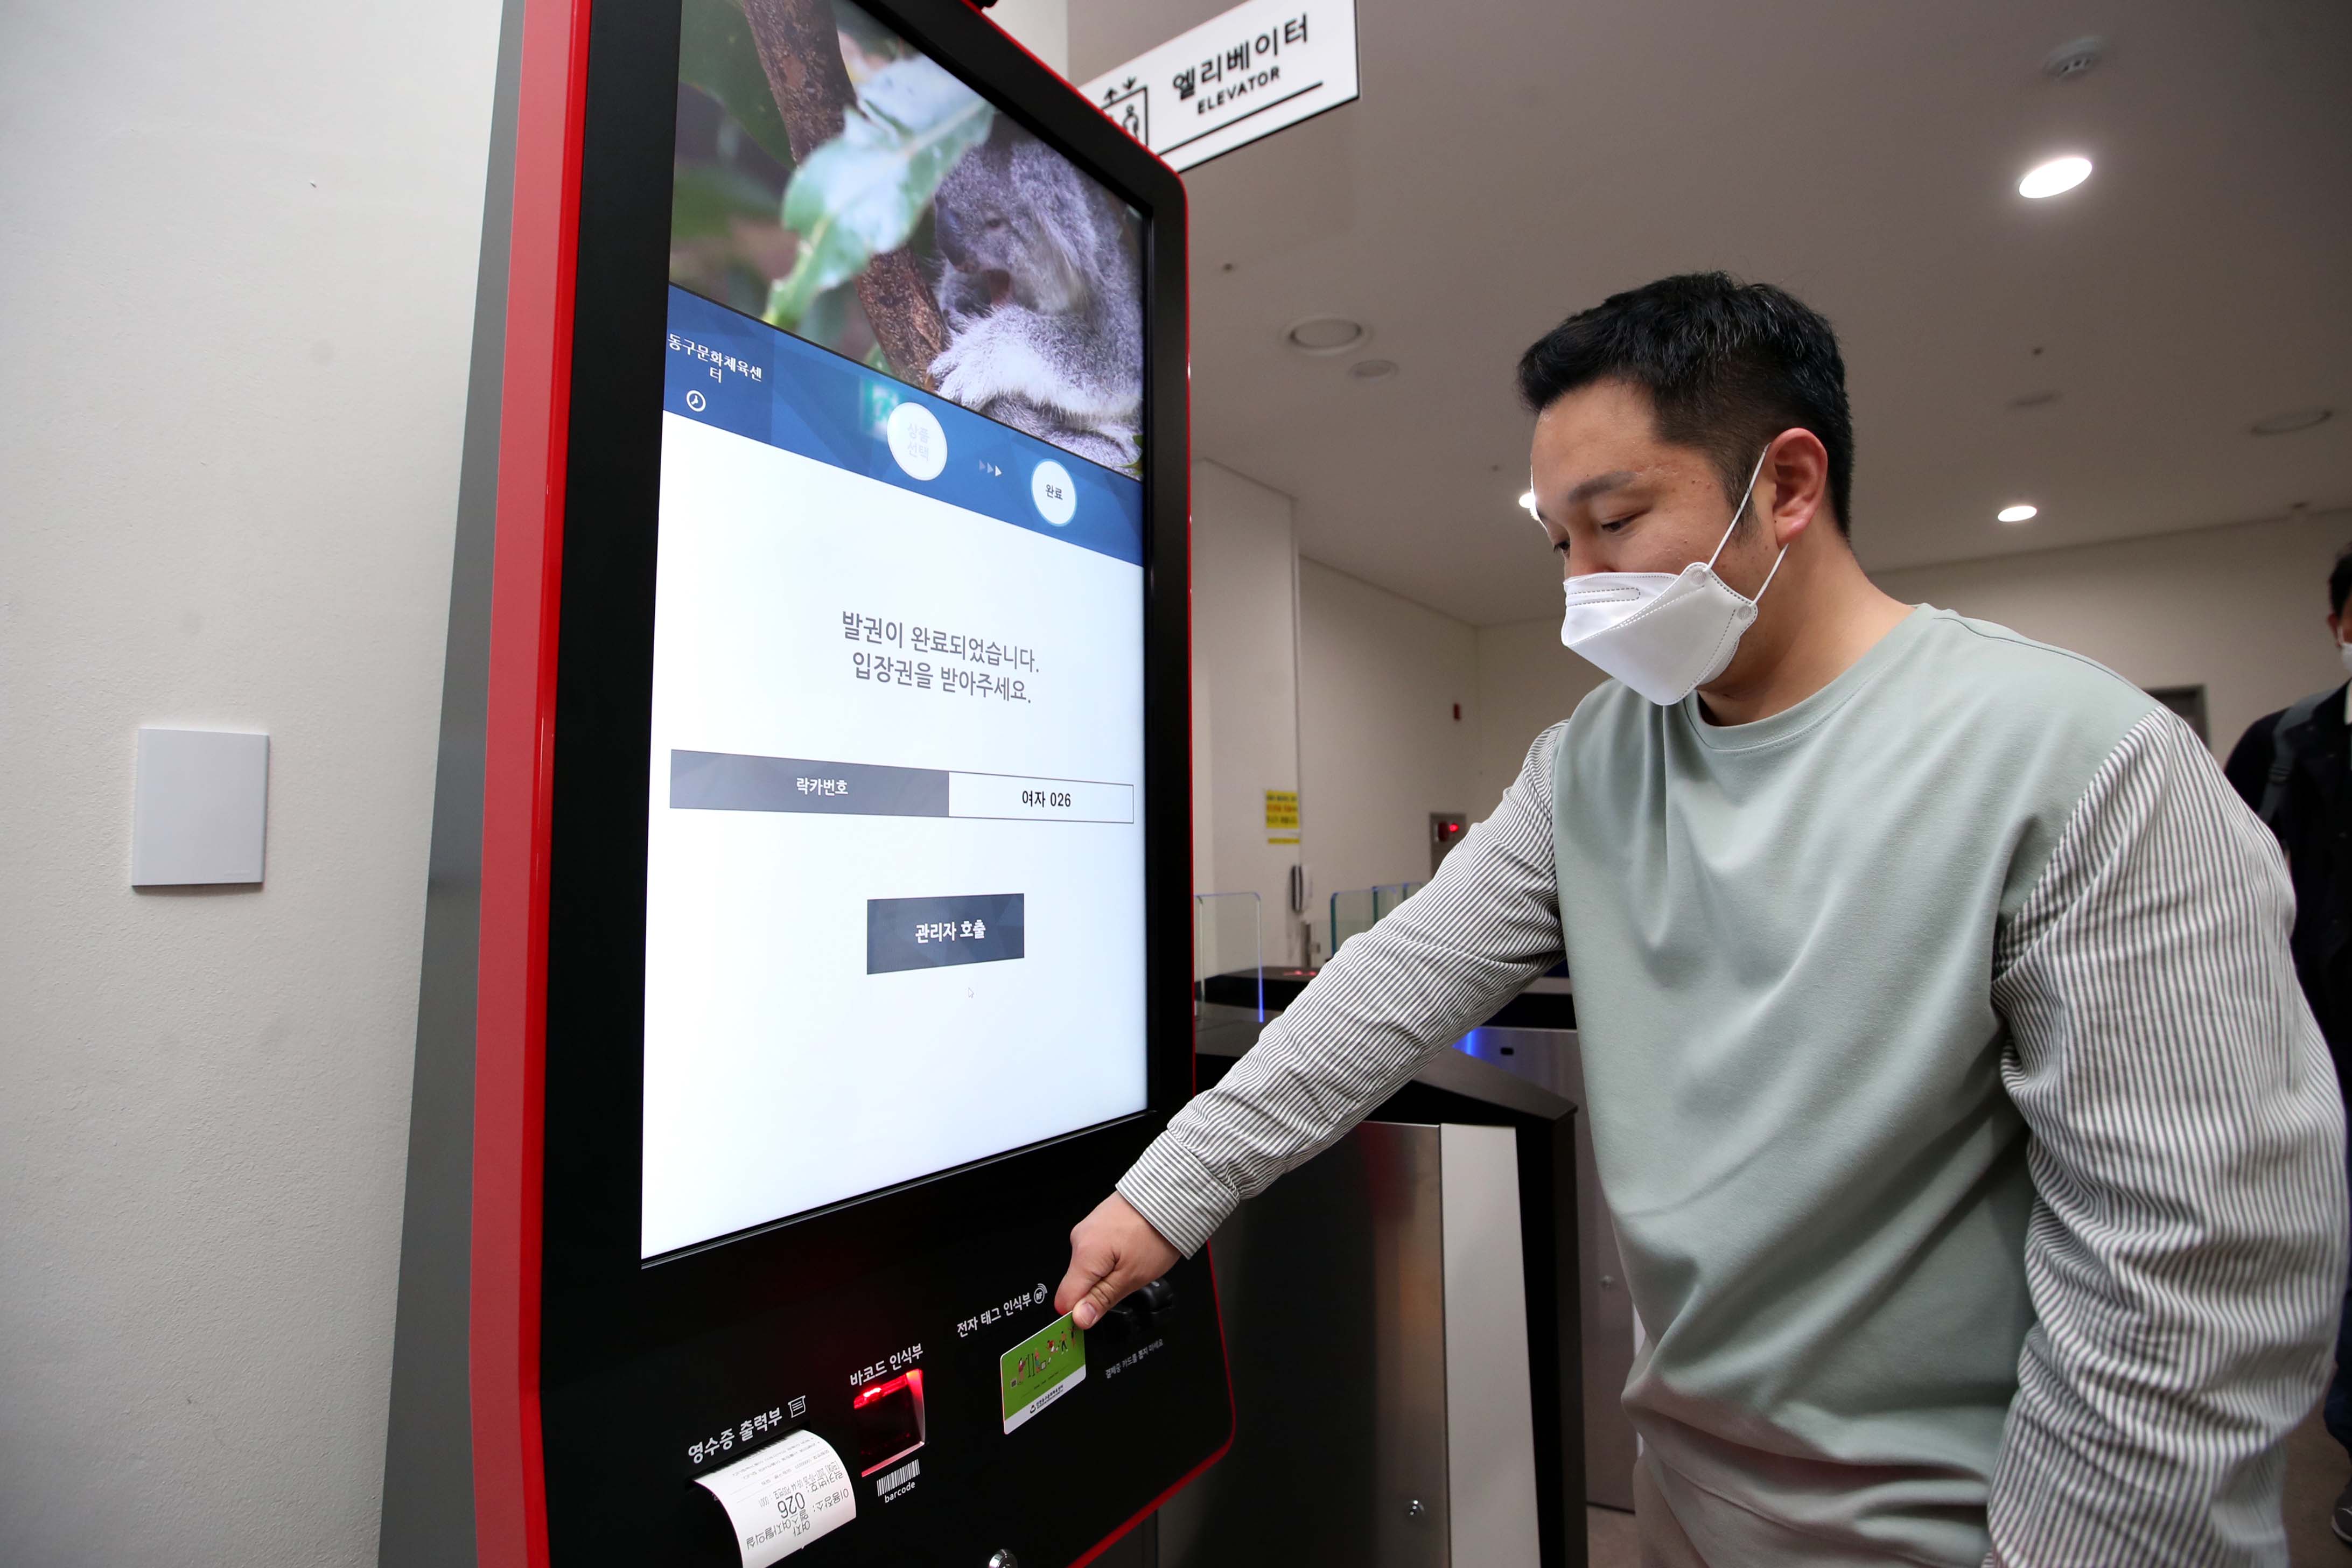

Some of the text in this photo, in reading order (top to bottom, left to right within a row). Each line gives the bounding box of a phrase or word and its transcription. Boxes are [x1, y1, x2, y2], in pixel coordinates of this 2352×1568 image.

[1172, 12, 1308, 101] 엘리베이터
[1196, 66, 1280, 115] ELEVATOR
[668, 333, 762, 382] 동구문화체육센
[710, 367, 722, 383] 터
[908, 423, 930, 444] 상품
[907, 442, 929, 461] 선택
[1045, 484, 1063, 500] 완료
[842, 611, 1039, 673] 발권이 완료되었습니다.
[852, 652, 1031, 704] 입장권을 받아주세요.
[796, 777, 849, 797] 락카번호
[1022, 790, 1071, 808] 여자 026
[915, 919, 986, 944] 관리자 호출
[957, 1292, 1032, 1338] 전자 태그 인식부
[850, 1343, 923, 1386] 바코드 인식부
[688, 1428, 735, 1464] 영수증
[739, 1407, 782, 1441] 출력부
[778, 1492, 806, 1518] 026
[884, 1482, 915, 1503] barcode
[793, 1521, 810, 1537] 여자
